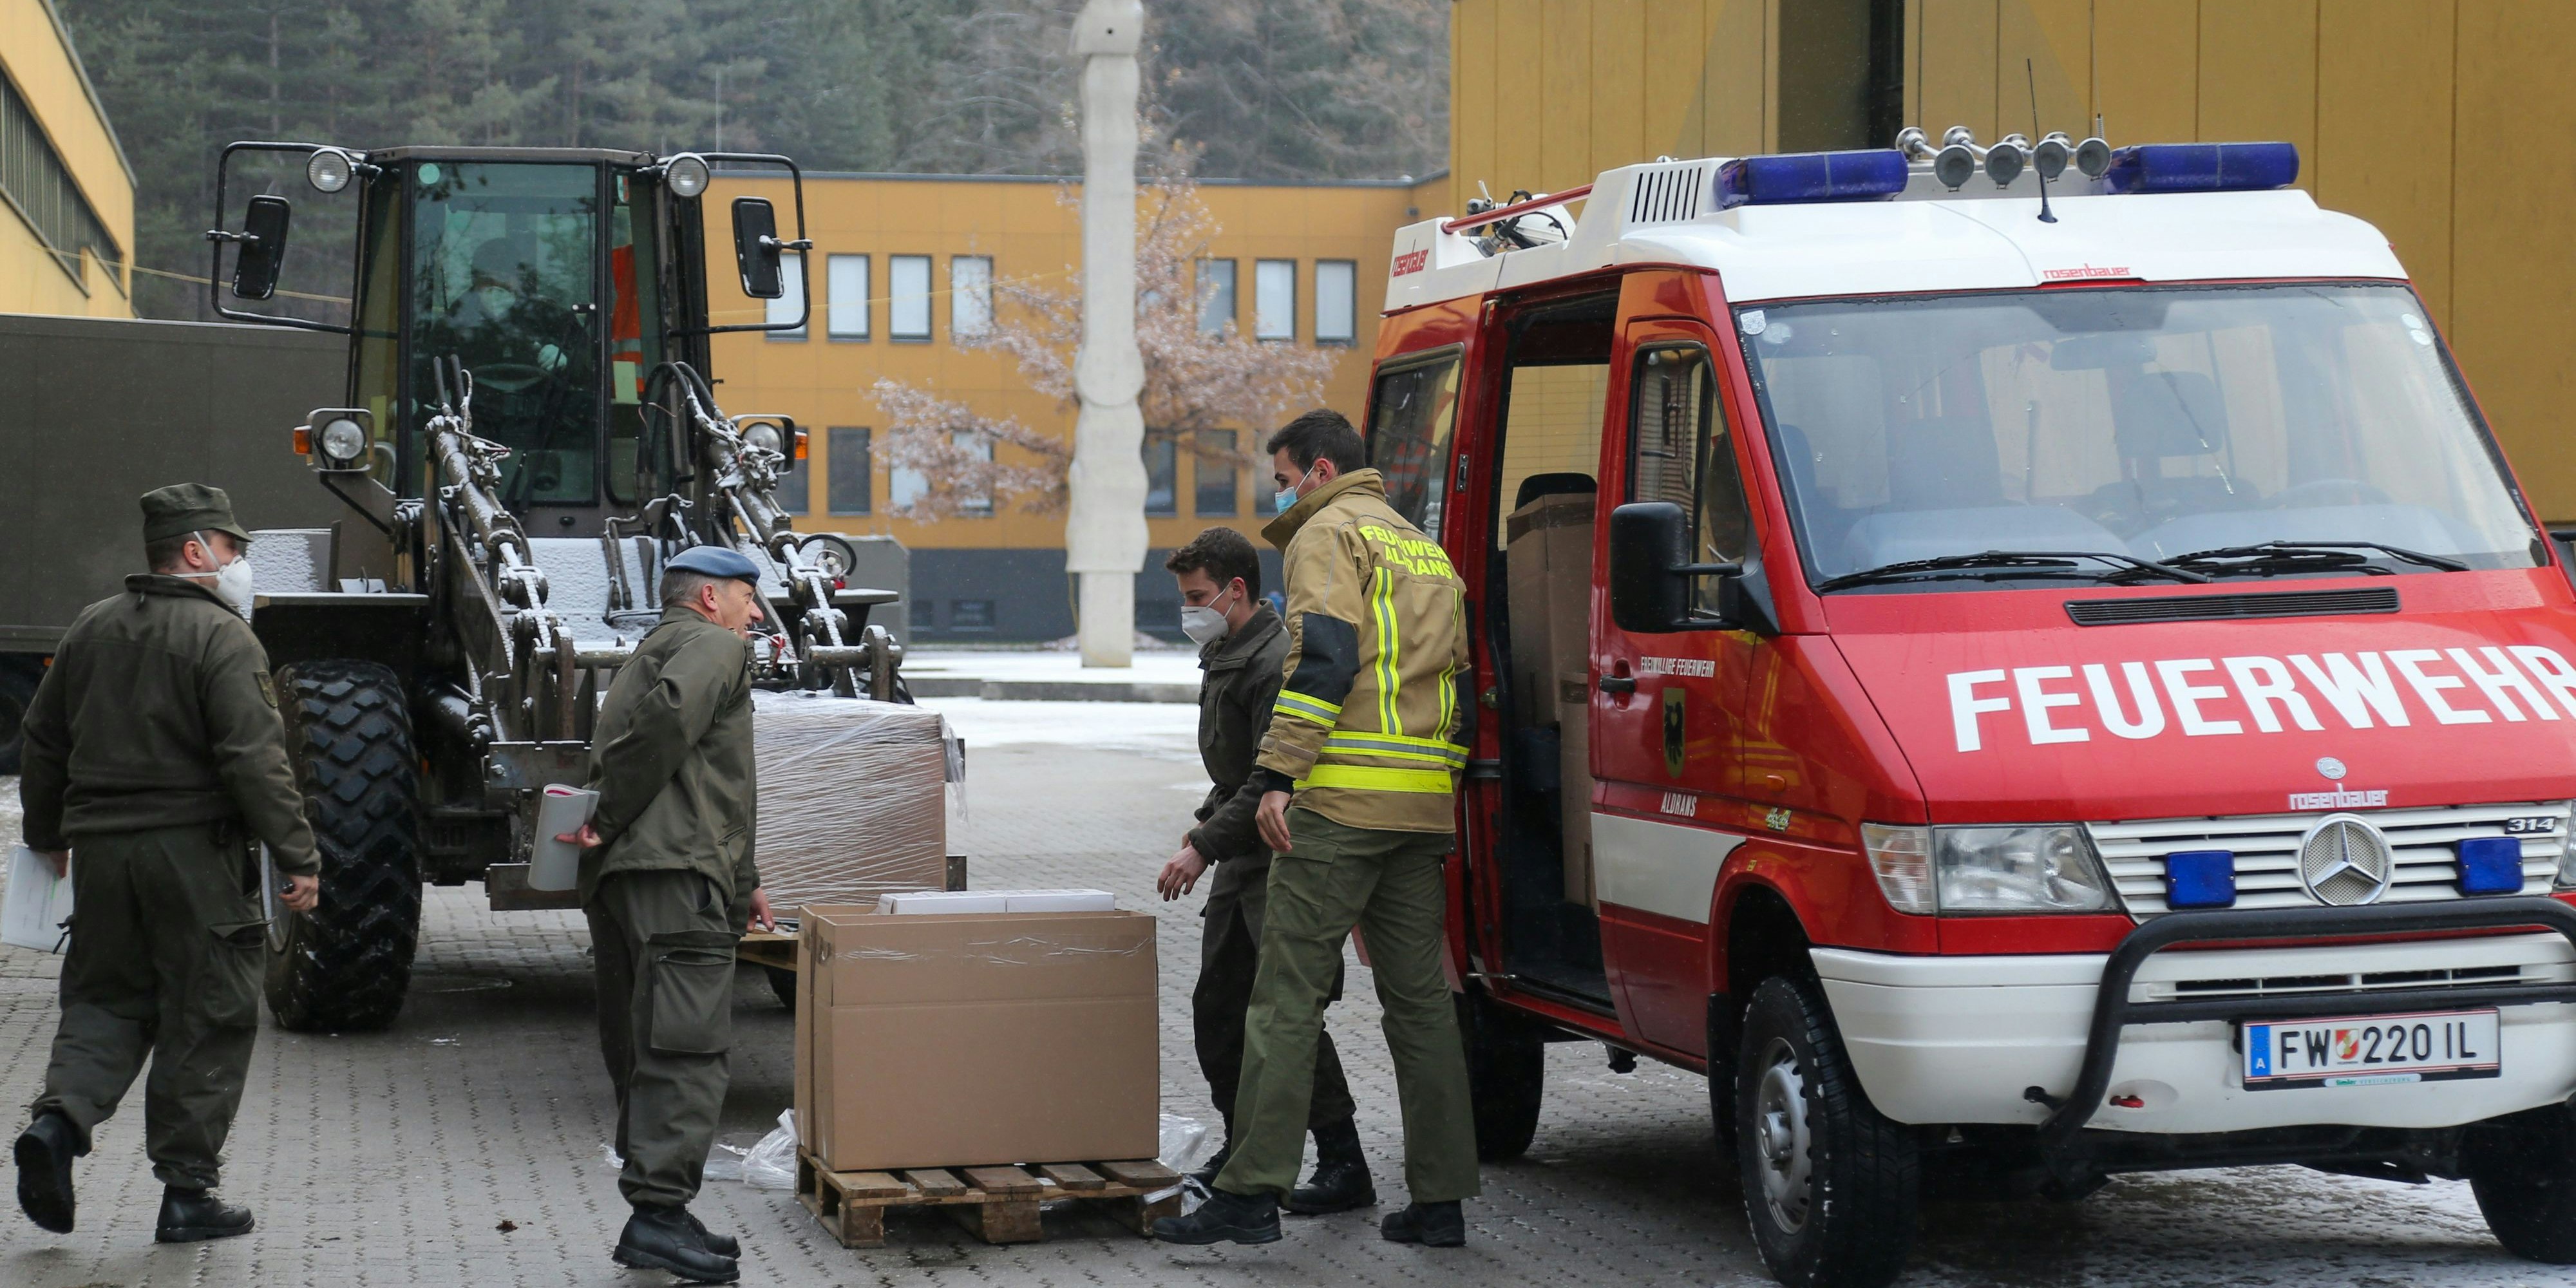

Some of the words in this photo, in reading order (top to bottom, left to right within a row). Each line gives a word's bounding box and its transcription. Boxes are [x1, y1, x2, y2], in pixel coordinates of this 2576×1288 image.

[2043, 263, 2130, 279] rosenbauer
[1385, 545, 1453, 580] ALRANS
[1641, 656, 1676, 675] FREIWILLIGE
[1676, 659, 1715, 677] FEUERWEHR
[1947, 645, 2576, 752] FEUERWEHR
[1660, 791, 1697, 817] ALDRANS
[2289, 782, 2389, 810] rosenbauer
[2508, 817, 2555, 831] 314
[2281, 1029, 2331, 1068] FW
[2363, 1024, 2431, 1063] 220
[2447, 1021, 2477, 1059] IL
[2256, 1058, 2266, 1069] A
